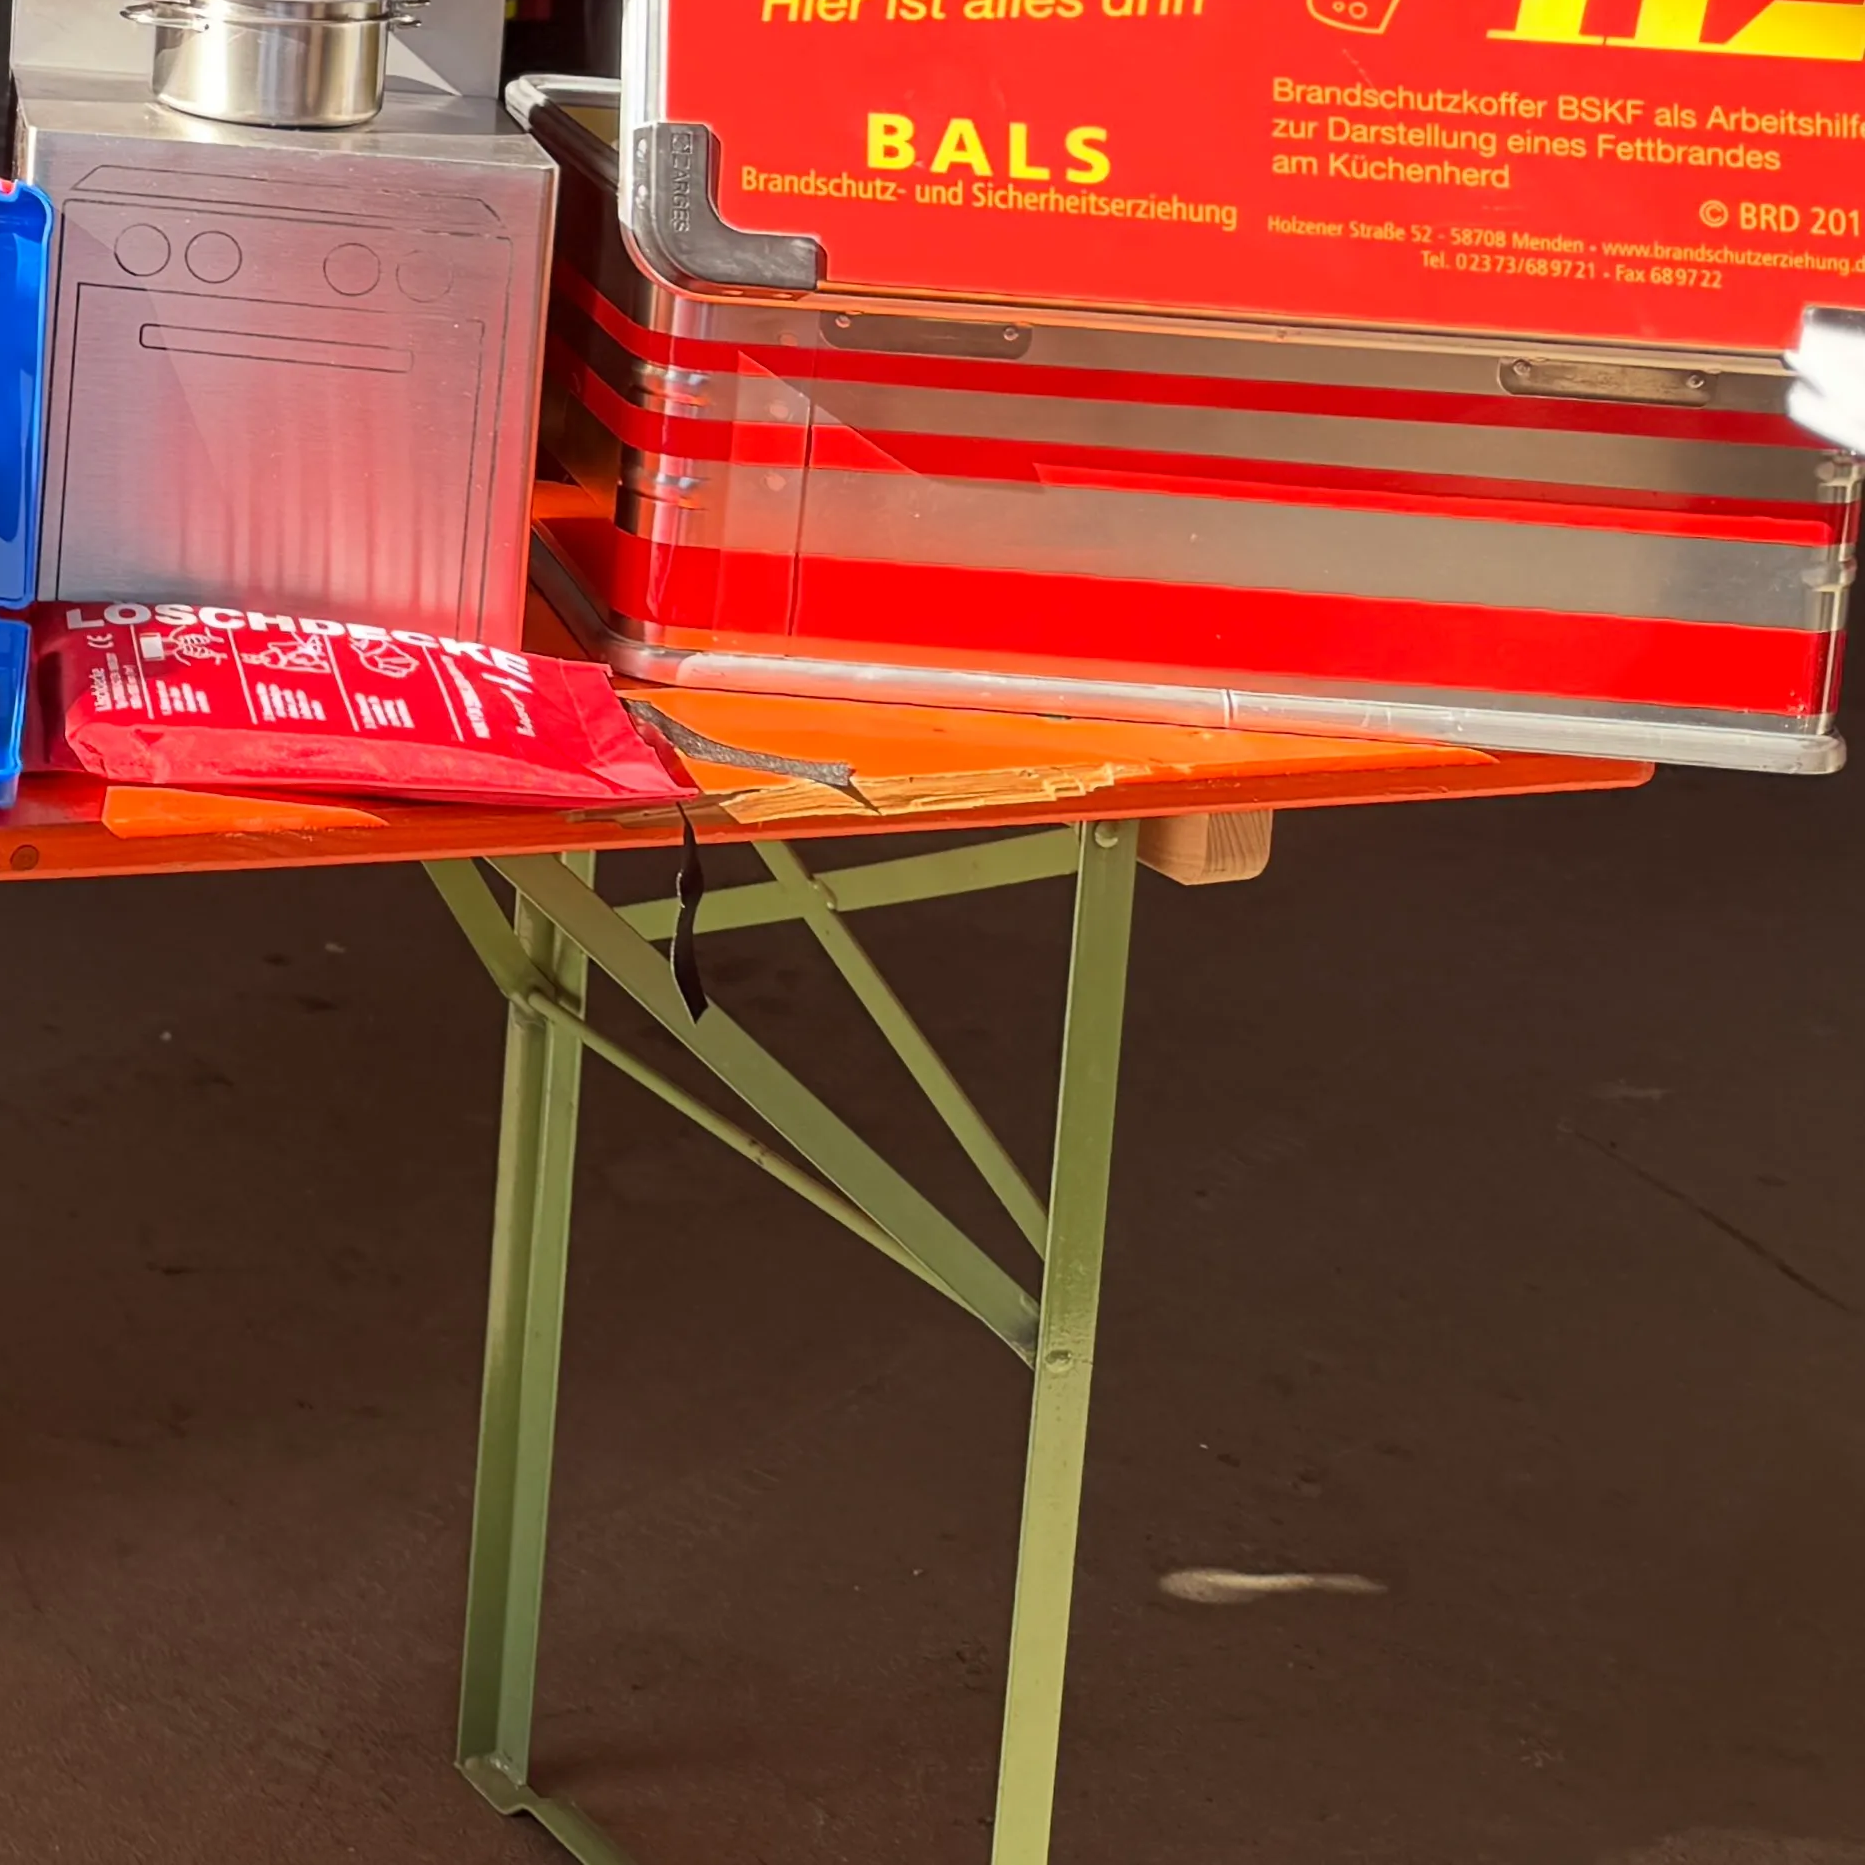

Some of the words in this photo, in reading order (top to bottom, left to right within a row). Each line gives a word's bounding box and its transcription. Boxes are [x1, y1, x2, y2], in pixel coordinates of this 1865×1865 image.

[1273, 77, 1546, 119] Brandschutzkoffer
[1558, 95, 1645, 126] BSKF
[1655, 103, 1697, 129] als
[1272, 118, 1315, 140] zur
[1327, 116, 1497, 156] Darstellung
[1507, 130, 1587, 157] eines
[1597, 133, 1781, 170] Fettbrandes
[1272, 156, 1318, 175] am
[1329, 152, 1510, 190] Küchenherd
[741, 165, 907, 202] Brandschutz-
[915, 180, 964, 206] und
[972, 182, 1239, 231] Sicherheitserziehung
[1740, 201, 1800, 234] BRD
[1267, 214, 1343, 237] Holzener
[1349, 219, 1405, 242] Straße
[1410, 223, 1433, 243] 52
[1450, 227, 1507, 249] 58708
[1511, 231, 1585, 254] Menden
[1421, 250, 1450, 271] Tel.
[1456, 252, 1597, 281] 02373/689721
[1615, 263, 1646, 285] Fax
[1650, 265, 1723, 290] 689722
